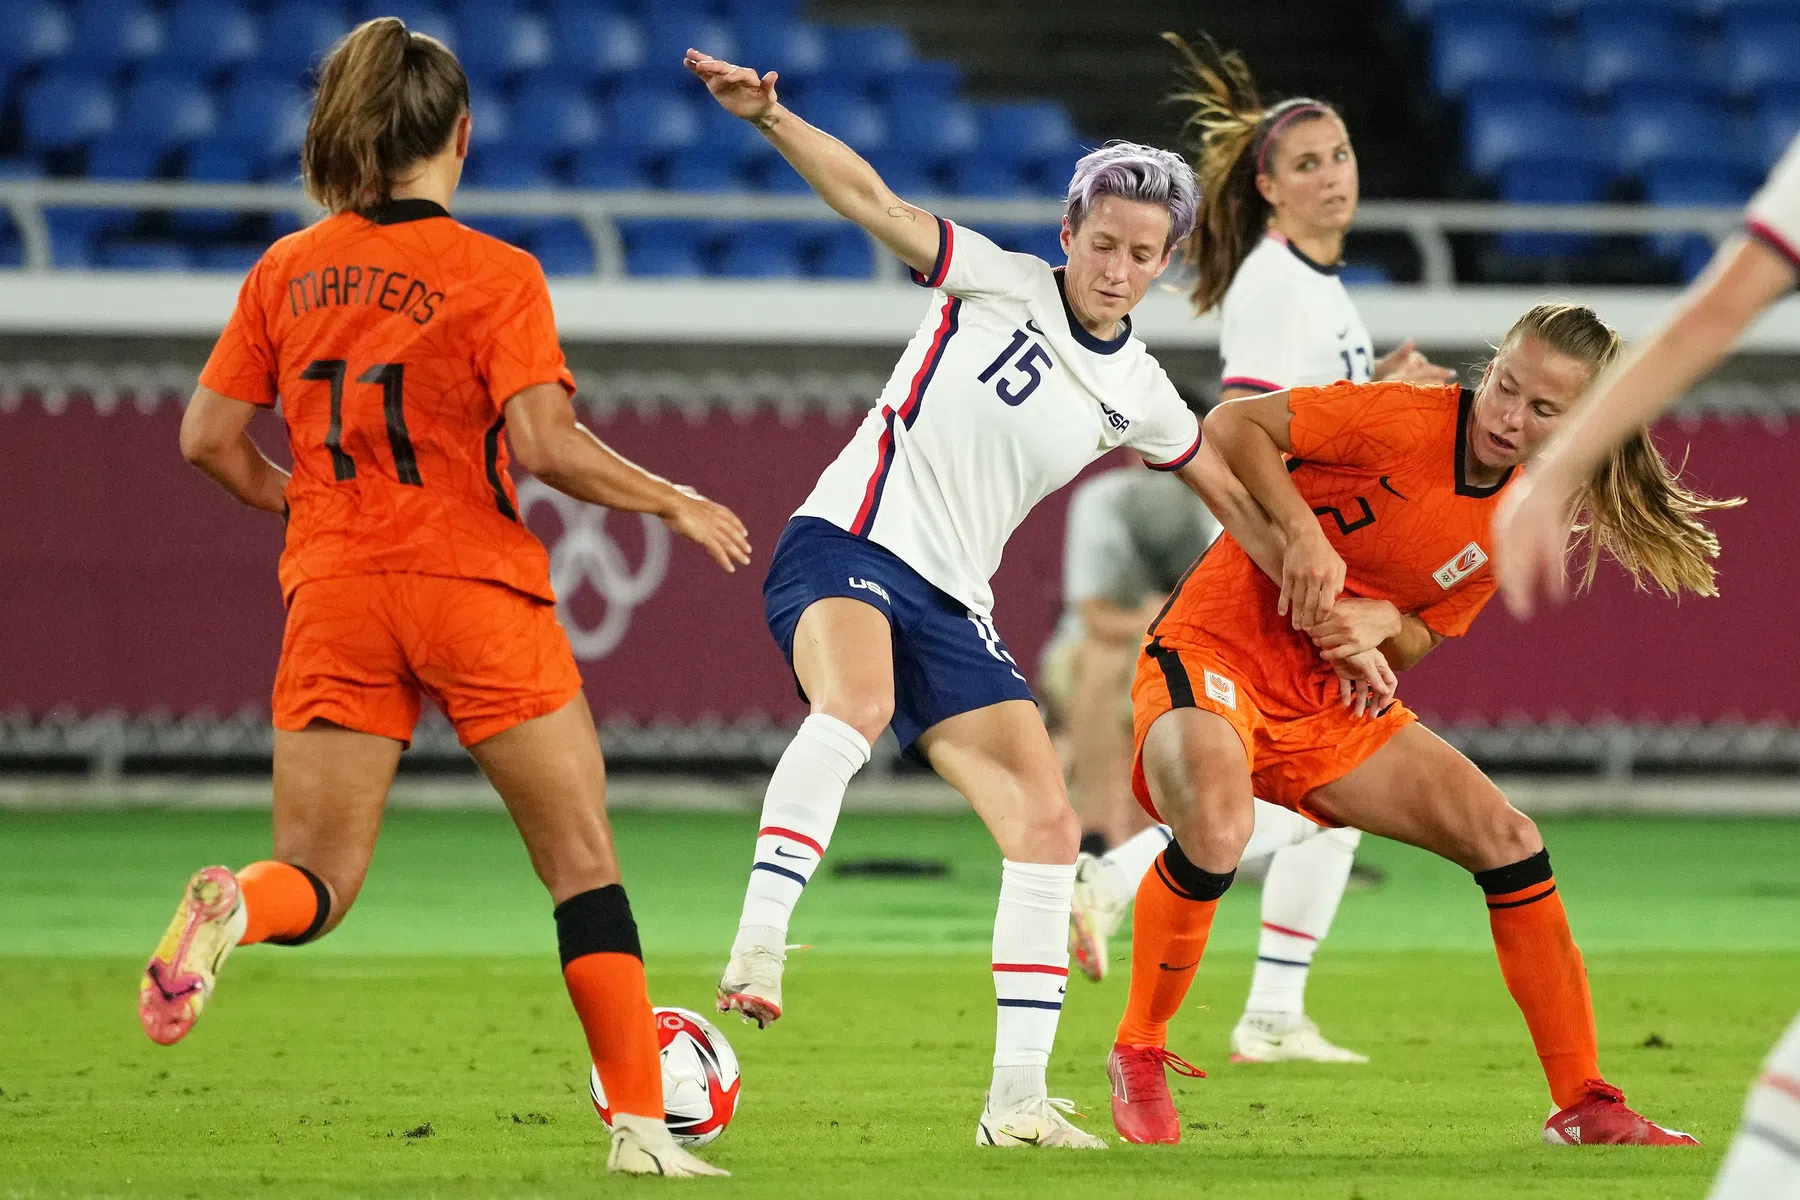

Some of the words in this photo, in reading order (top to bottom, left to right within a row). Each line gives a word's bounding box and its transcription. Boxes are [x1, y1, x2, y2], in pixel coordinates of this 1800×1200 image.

[288, 266, 445, 325] MARTENS
[977, 328, 1053, 406] 15
[300, 360, 424, 487] 11
[1101, 402, 1130, 434] USA
[1312, 496, 1377, 536] 2
[848, 576, 891, 605] USA
